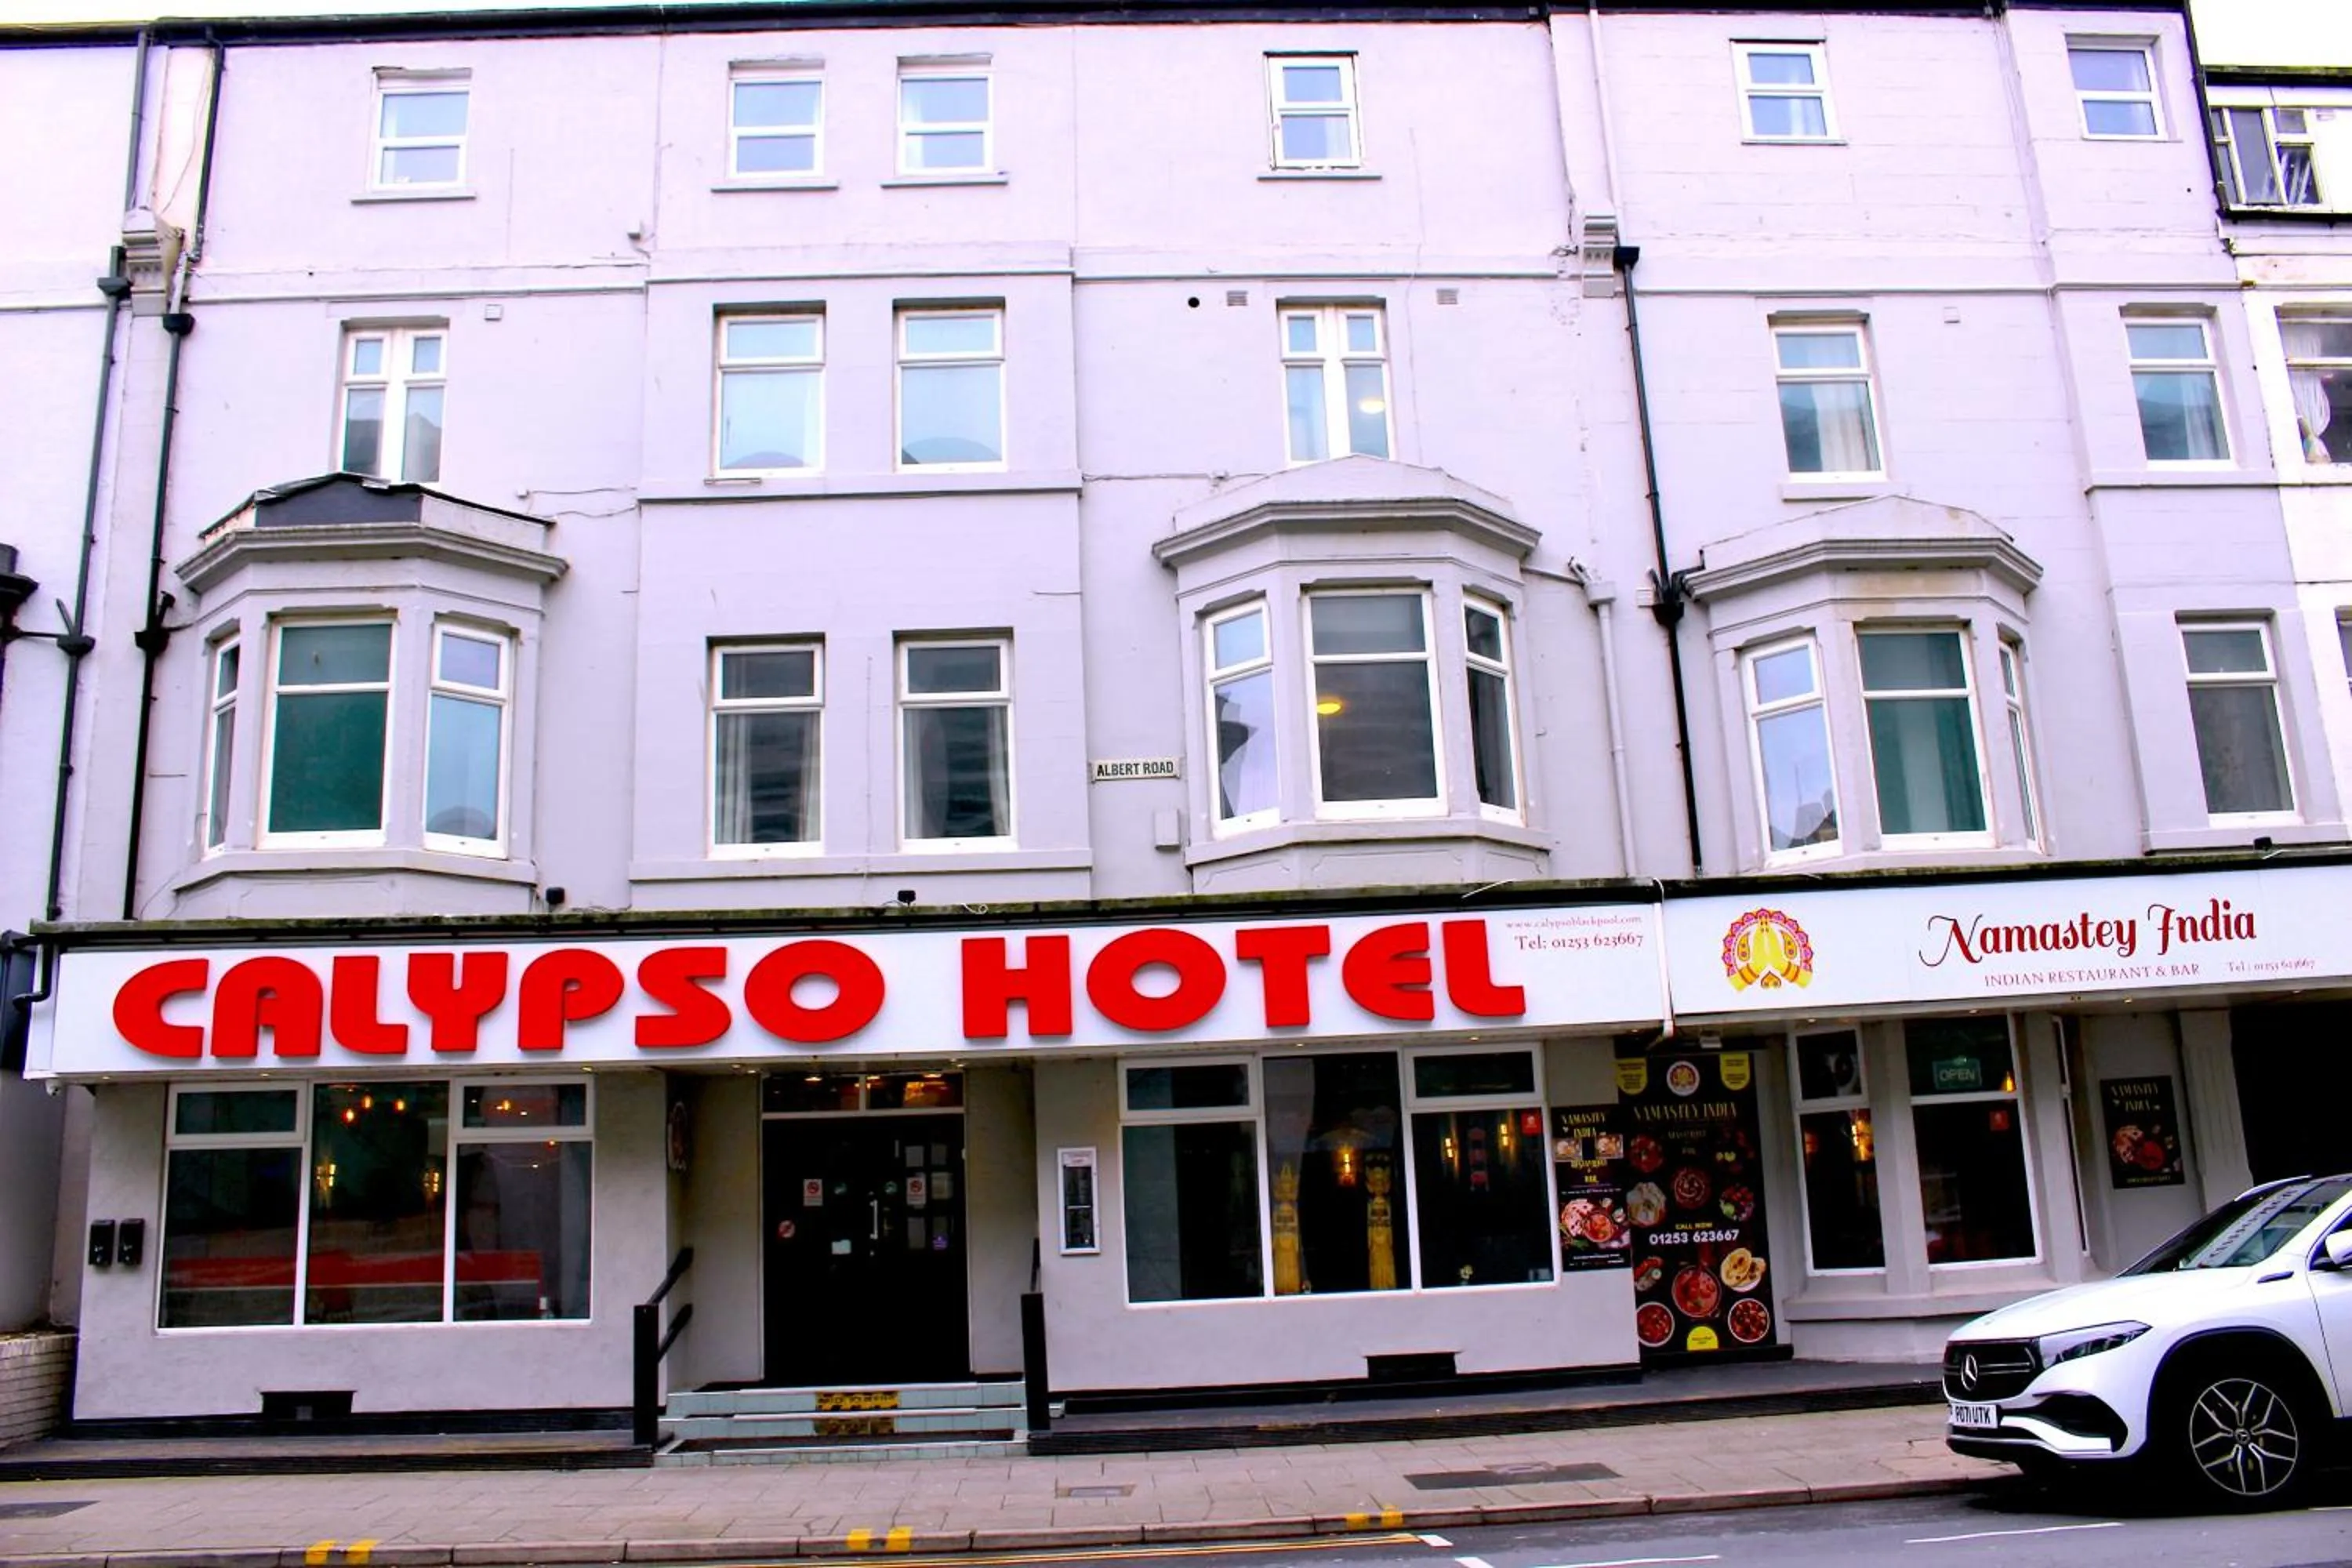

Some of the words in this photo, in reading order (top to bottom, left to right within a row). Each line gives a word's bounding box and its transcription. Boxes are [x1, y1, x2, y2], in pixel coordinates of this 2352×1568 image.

[1098, 763, 1140, 776] ALBERT
[1143, 761, 1174, 774] ROAD
[1505, 915, 1642, 928] www.calypsoblackpool.com
[1514, 935, 1547, 950] Tel:
[1552, 937, 1589, 949] 01253
[1594, 932, 1644, 947] 623667
[1918, 912, 2137, 967] Namastey
[2147, 898, 2257, 956] India
[1984, 971, 2044, 987] INDIAN
[2048, 966, 2151, 984] RESTAURANT
[2155, 965, 2167, 977] &
[2171, 963, 2200, 976] BAR
[113, 941, 884, 1058] CALYPSO
[962, 920, 1526, 1038] HOTEL
[1940, 1068, 1976, 1081] OPEN
[1703, 1101, 1738, 1119] INDIA
[1649, 1232, 1688, 1245] 01253
[1693, 1229, 1740, 1243] 623667
